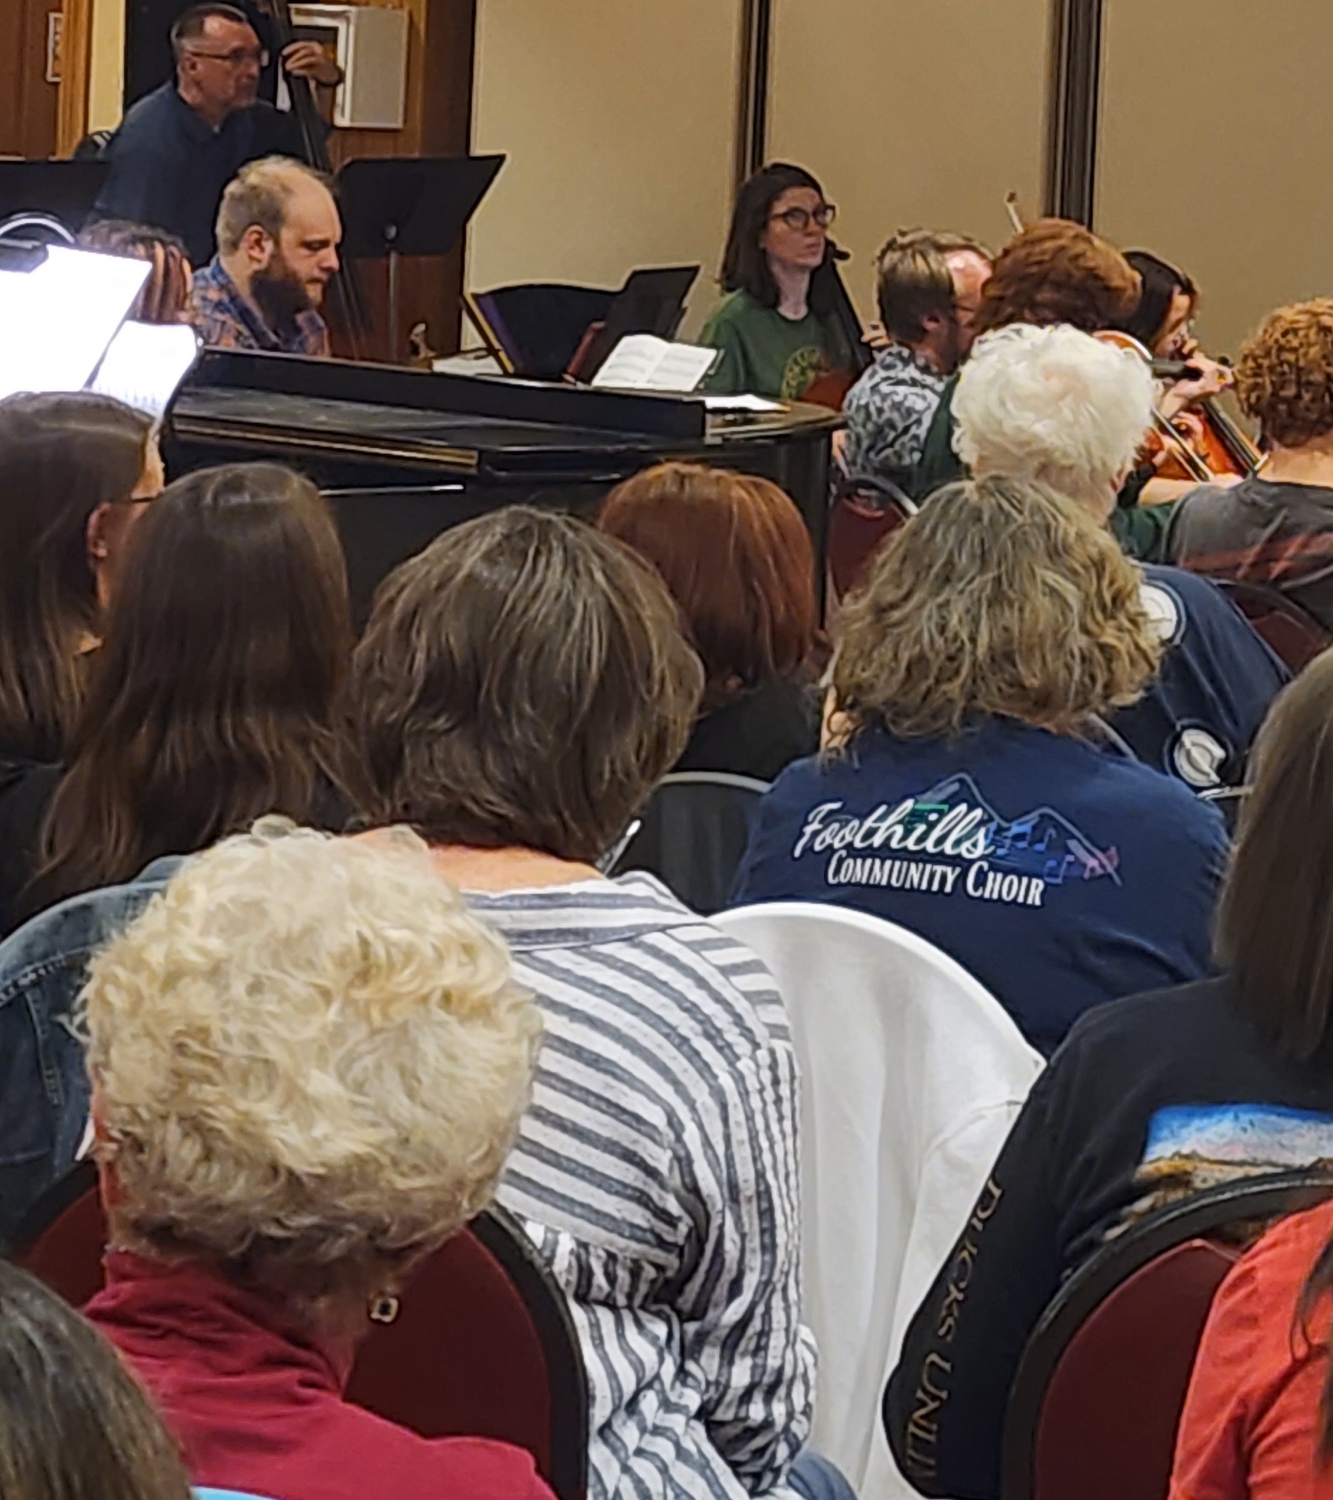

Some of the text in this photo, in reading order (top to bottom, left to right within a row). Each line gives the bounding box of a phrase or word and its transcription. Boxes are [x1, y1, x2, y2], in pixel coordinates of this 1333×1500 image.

[793, 797, 996, 859] Foothills
[827, 849, 1045, 907] COMMUNITY CHOIR
